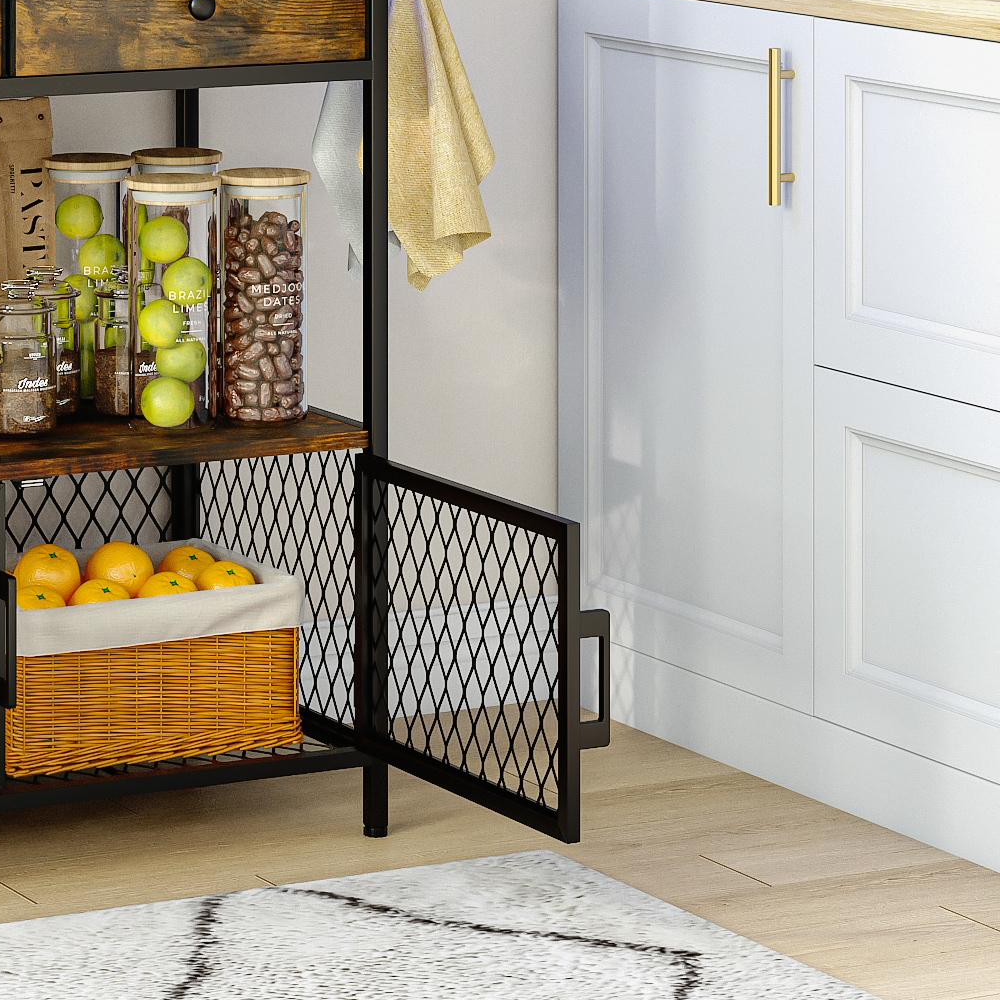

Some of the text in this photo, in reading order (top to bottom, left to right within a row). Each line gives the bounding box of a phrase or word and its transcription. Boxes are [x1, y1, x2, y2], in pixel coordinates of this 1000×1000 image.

[168, 288, 212, 301] BRAZIL
[263, 295, 300, 307] DATES
[172, 301, 209, 314] LIMES
